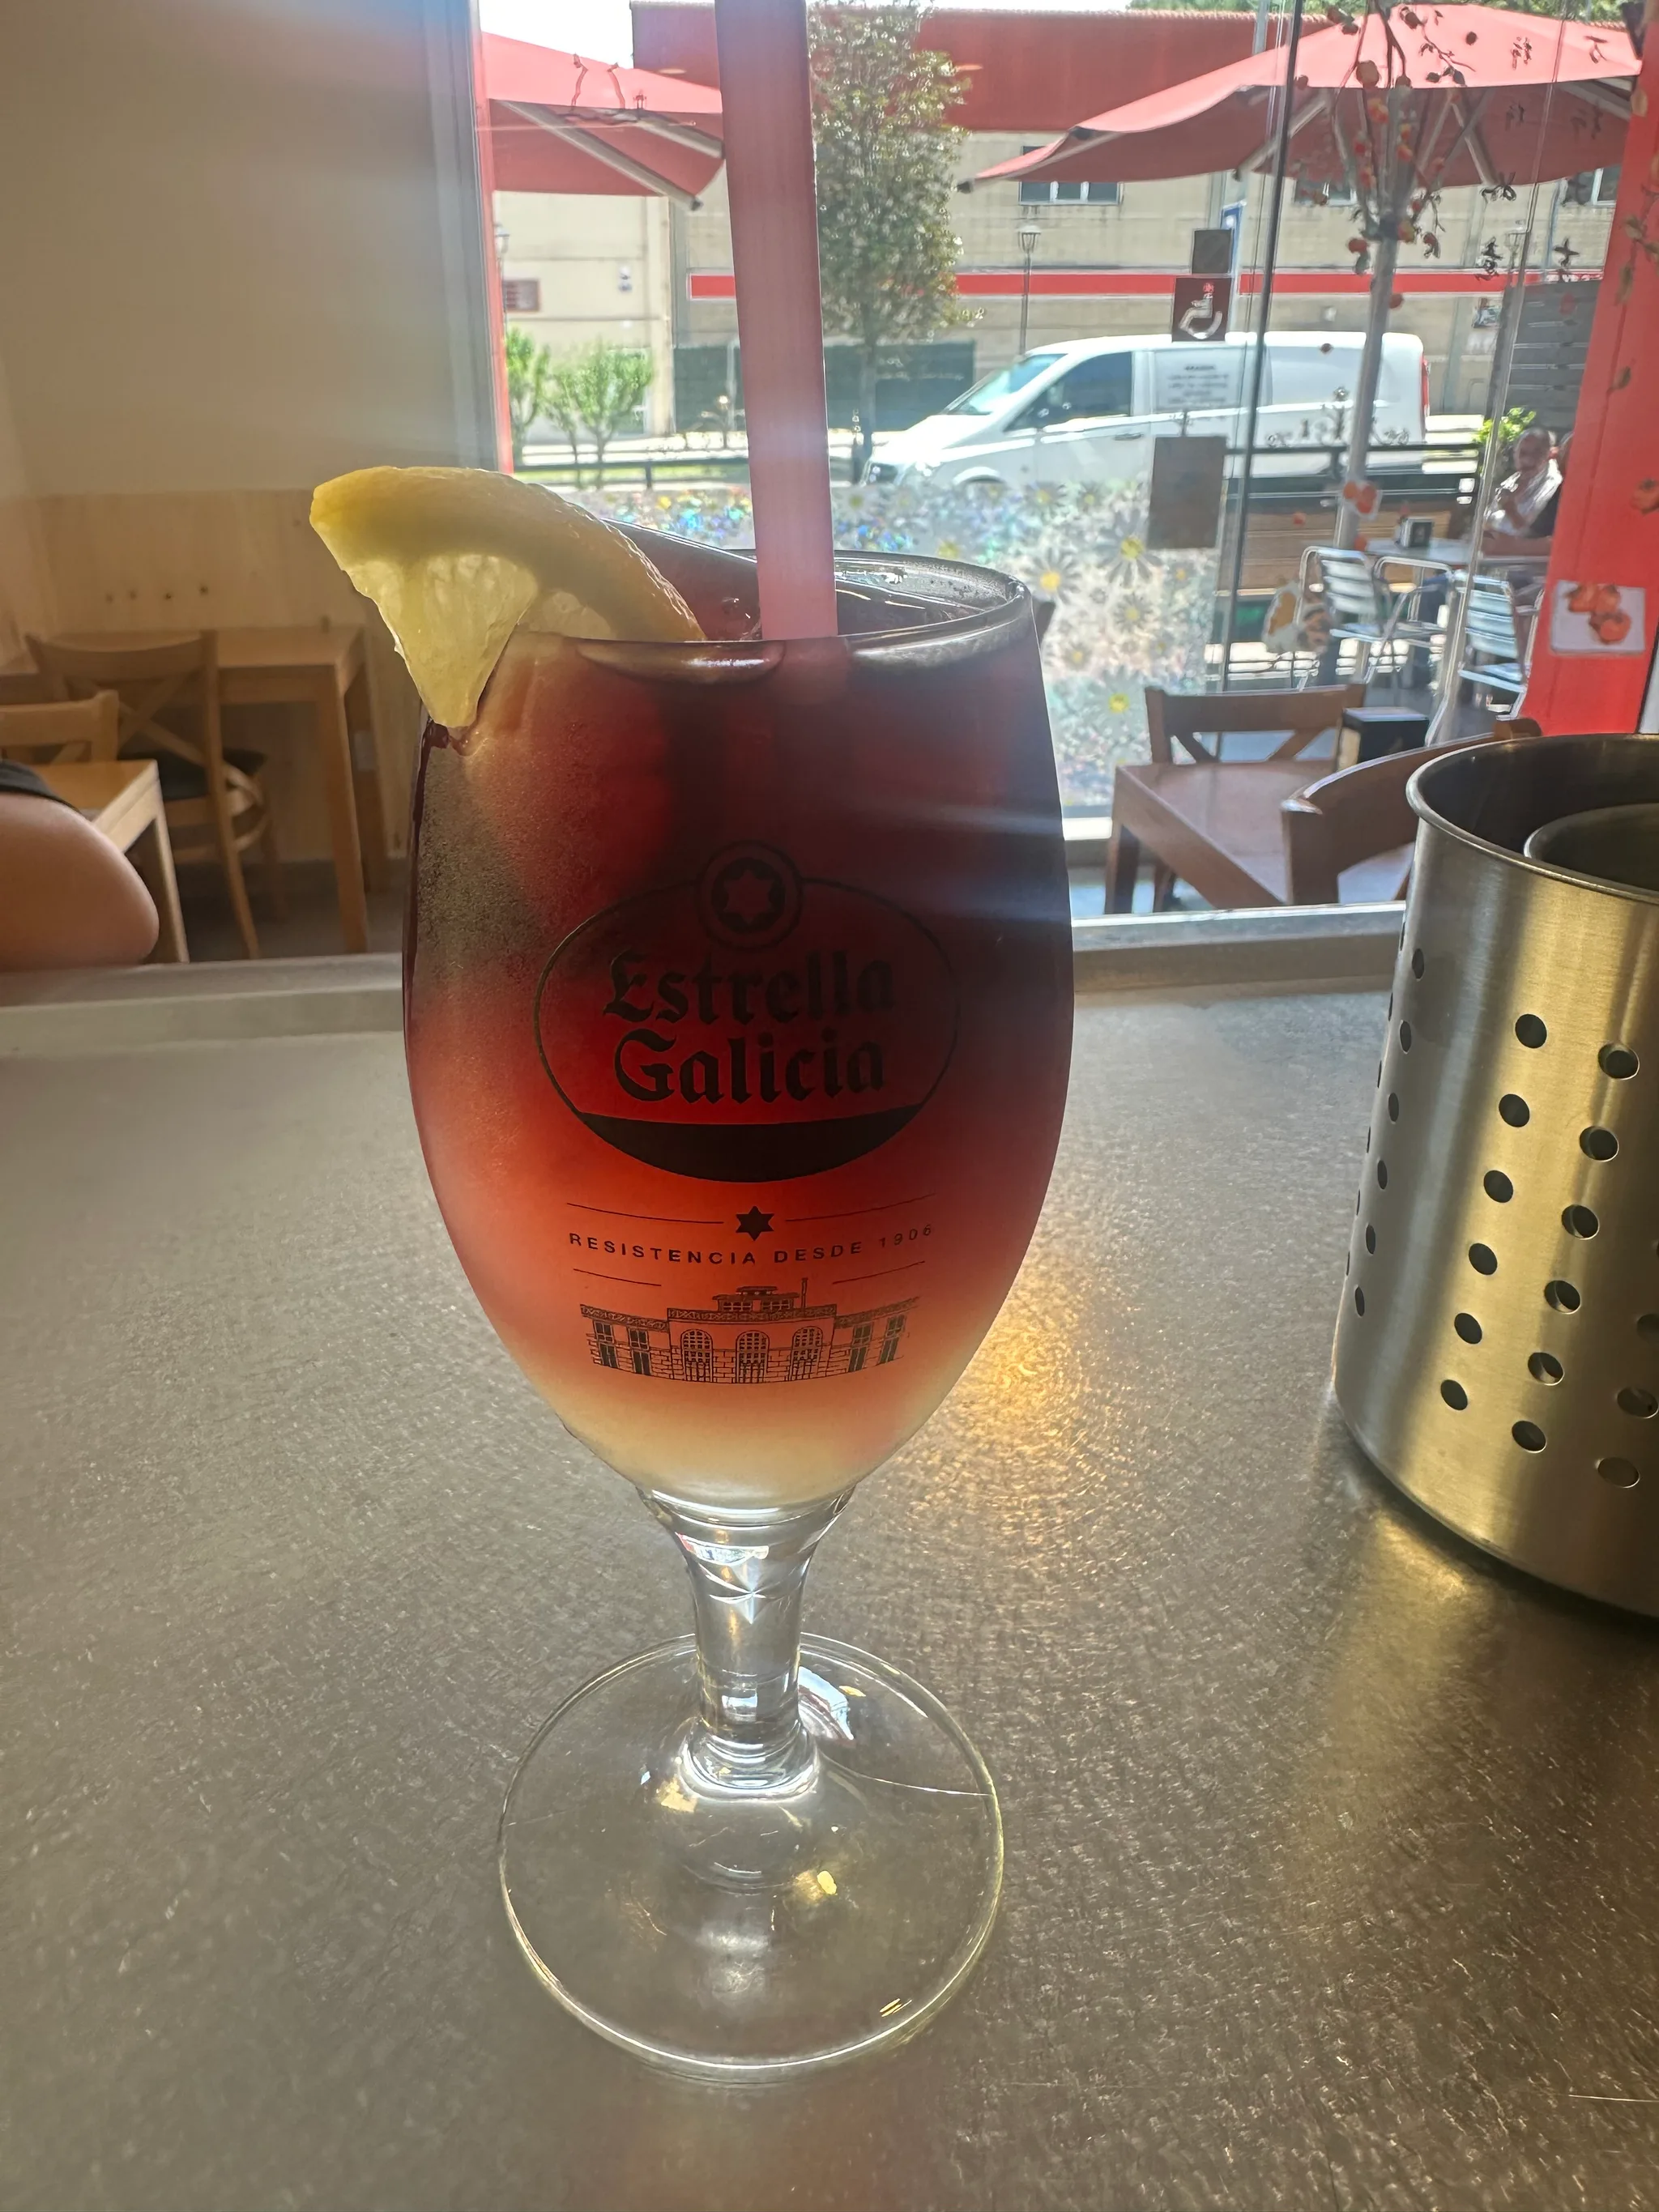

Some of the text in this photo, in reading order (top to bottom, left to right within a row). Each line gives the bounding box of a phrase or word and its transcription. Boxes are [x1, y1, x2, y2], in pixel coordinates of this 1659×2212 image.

[603, 948, 898, 1025] Estrella
[613, 1027, 887, 1105] Galicia
[569, 1224, 932, 1265] RESISTENCIA DESDE 1906
